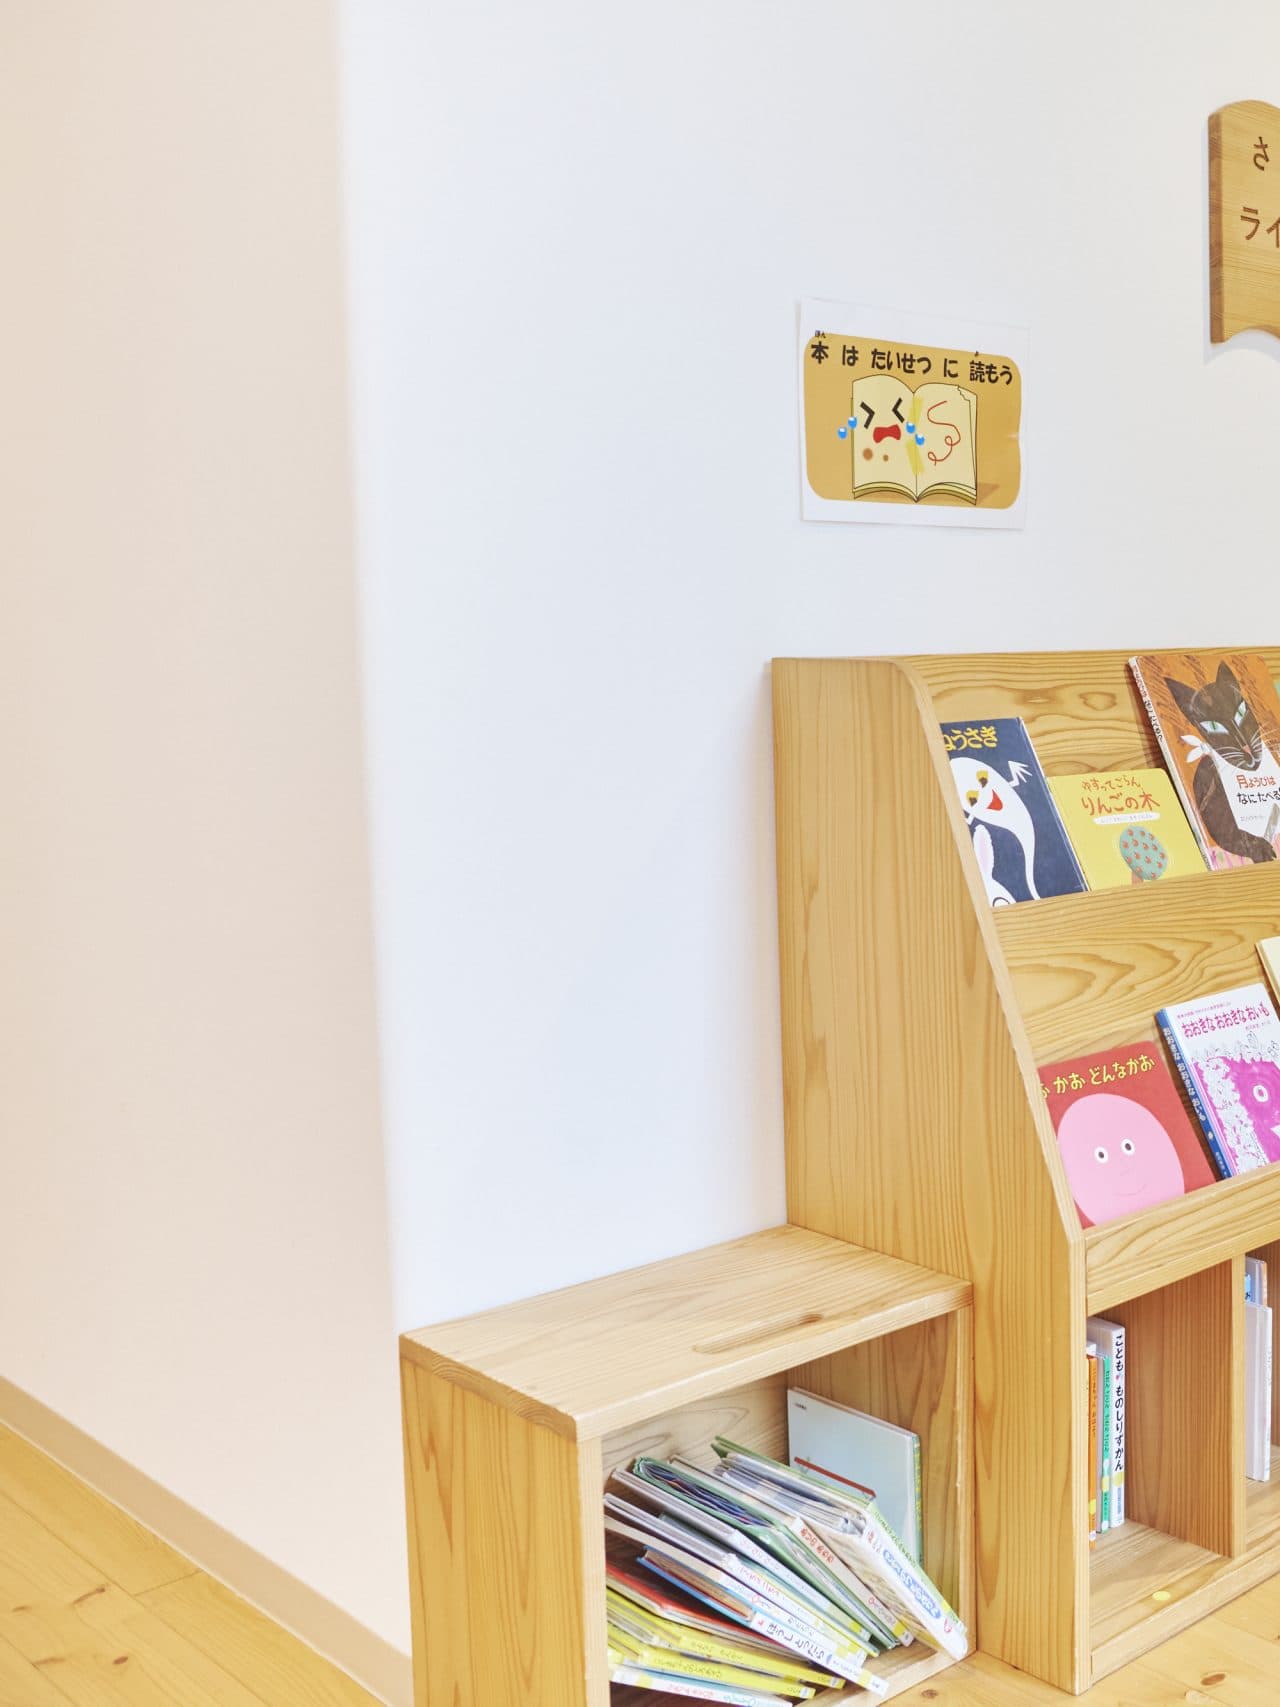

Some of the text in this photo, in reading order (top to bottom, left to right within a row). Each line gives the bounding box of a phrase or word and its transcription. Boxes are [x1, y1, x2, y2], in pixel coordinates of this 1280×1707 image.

[810, 341, 1013, 385] 本 は たいせつ に 読もう
[1081, 789, 1160, 816] りんごの木
[1053, 1072, 1086, 1094] かお
[1089, 1054, 1155, 1085] どんなかお
